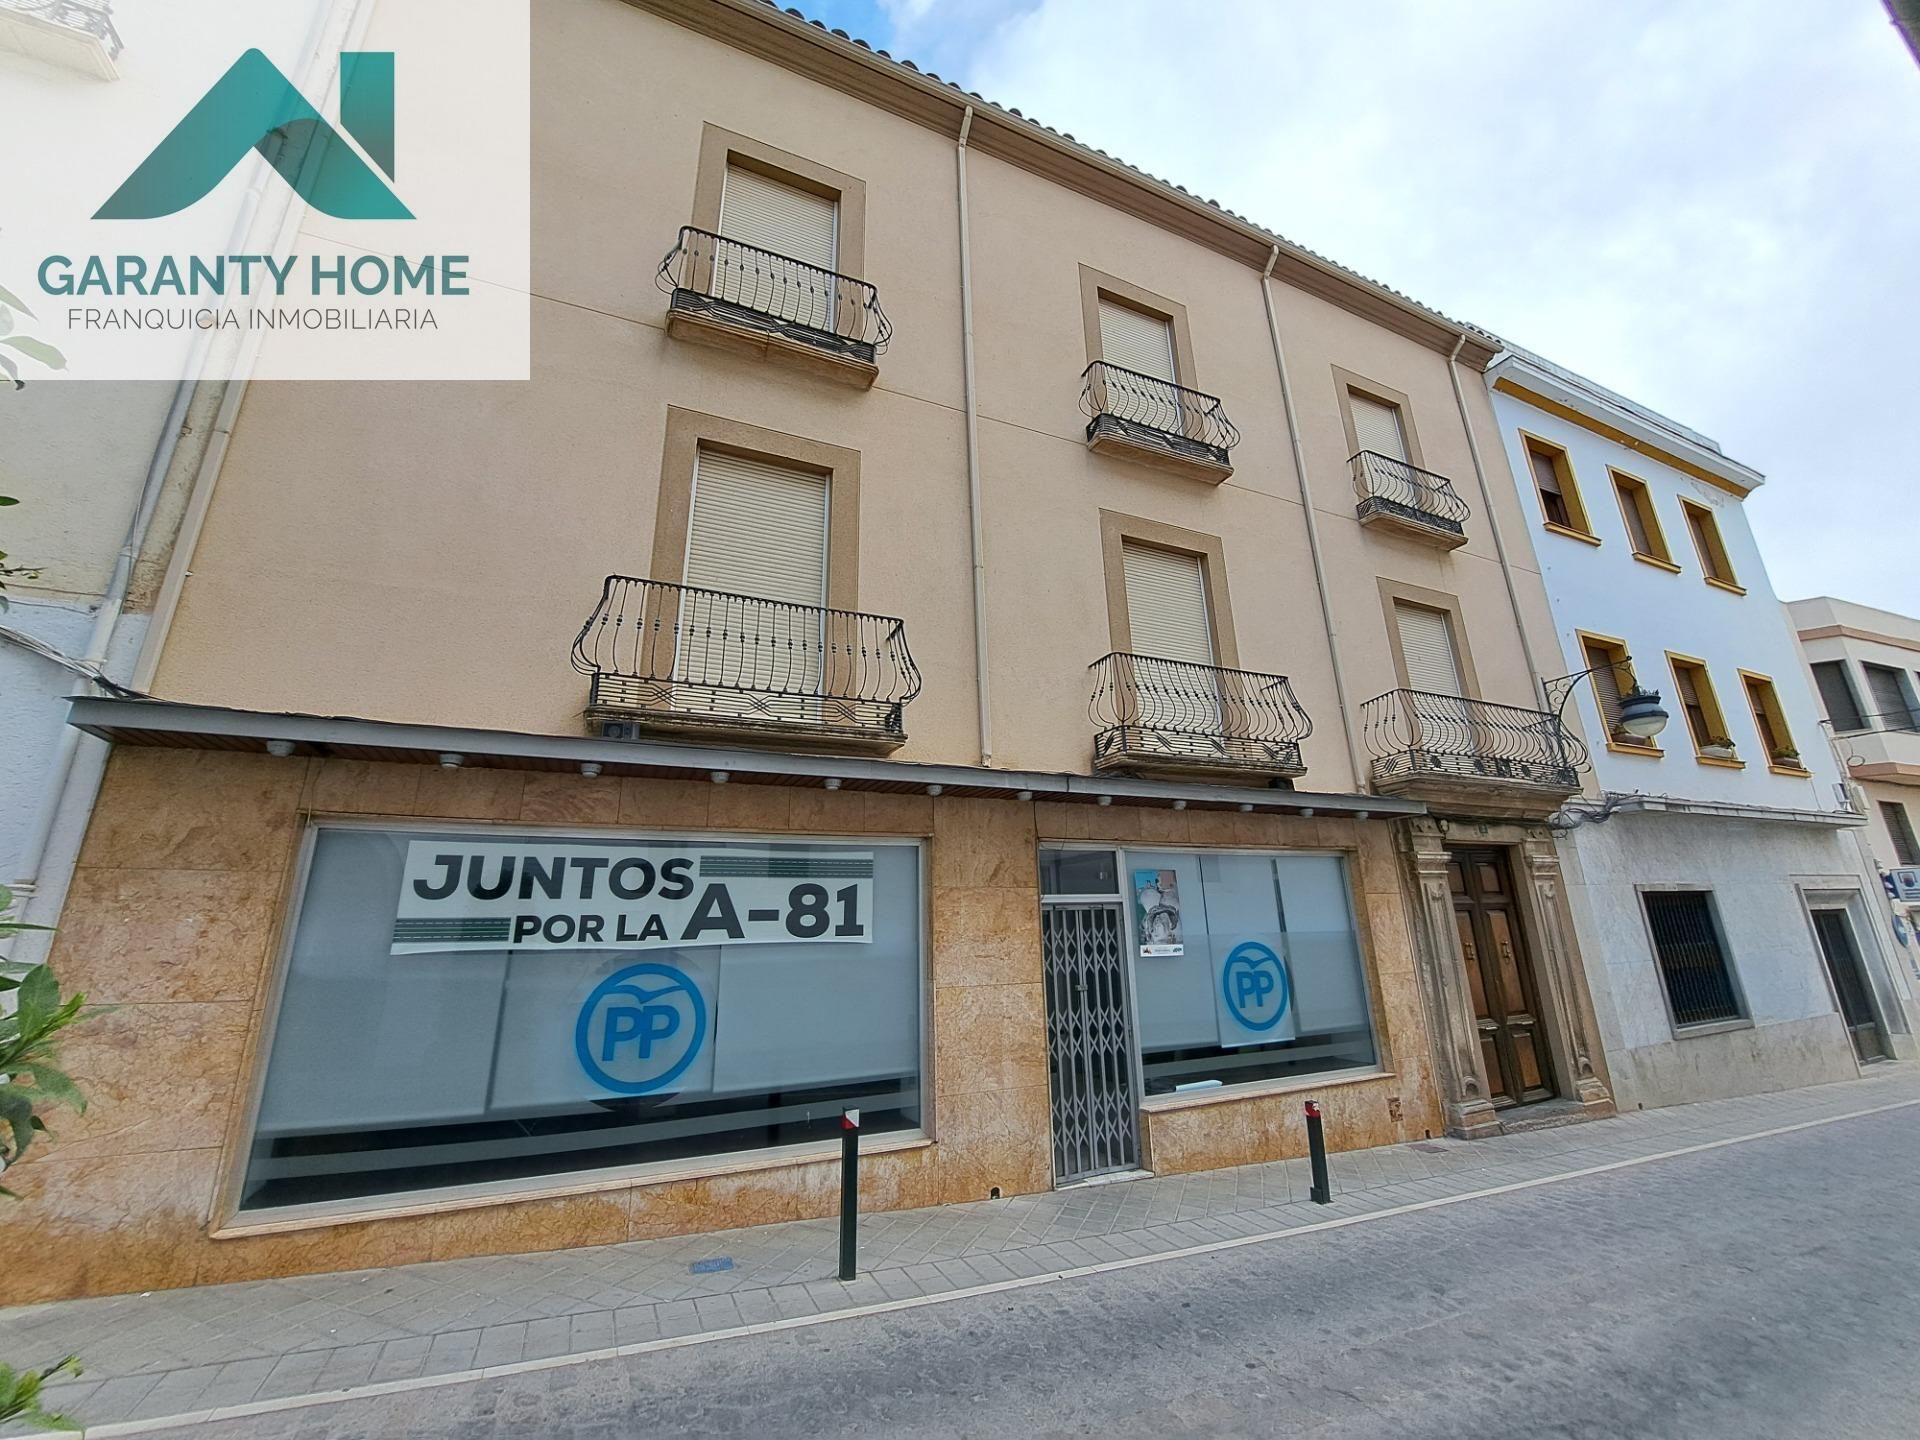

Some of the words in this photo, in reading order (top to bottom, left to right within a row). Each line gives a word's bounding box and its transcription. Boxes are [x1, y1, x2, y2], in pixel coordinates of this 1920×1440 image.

[413, 854, 694, 900] JUNTOS
[512, 913, 604, 945] POR
[615, 913, 669, 942] LA
[680, 882, 866, 940] A-81
[1236, 970, 1274, 1009] PP
[602, 1005, 680, 1062] PP
